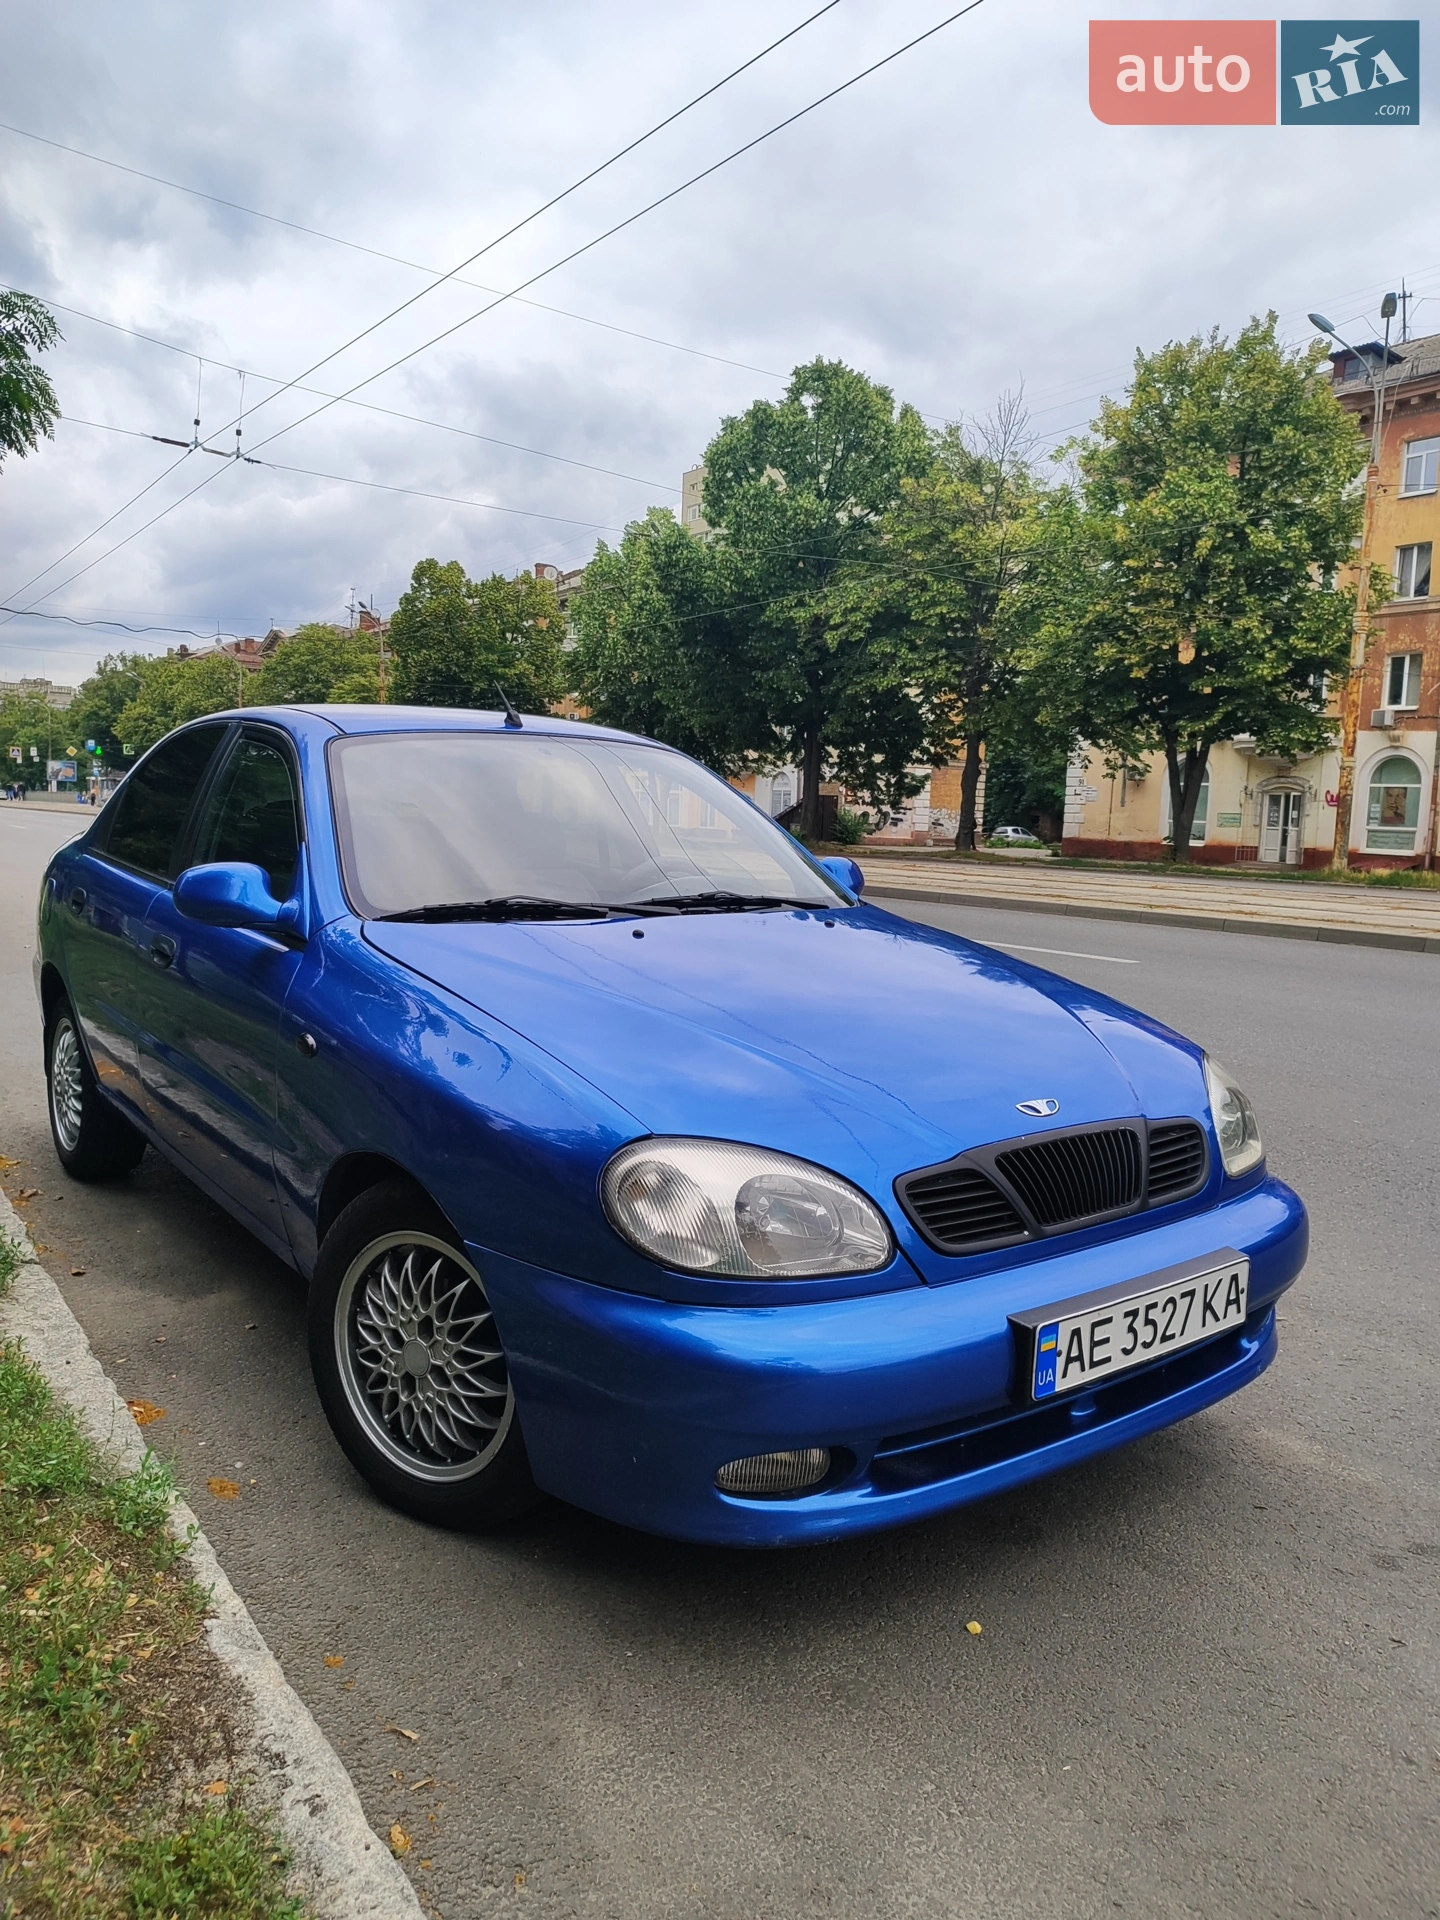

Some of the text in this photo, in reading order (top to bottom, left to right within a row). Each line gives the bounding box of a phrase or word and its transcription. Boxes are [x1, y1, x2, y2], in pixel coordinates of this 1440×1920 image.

[1061, 1272, 1242, 1380] AE 3527 KA
[1038, 1367, 1054, 1386] UA
